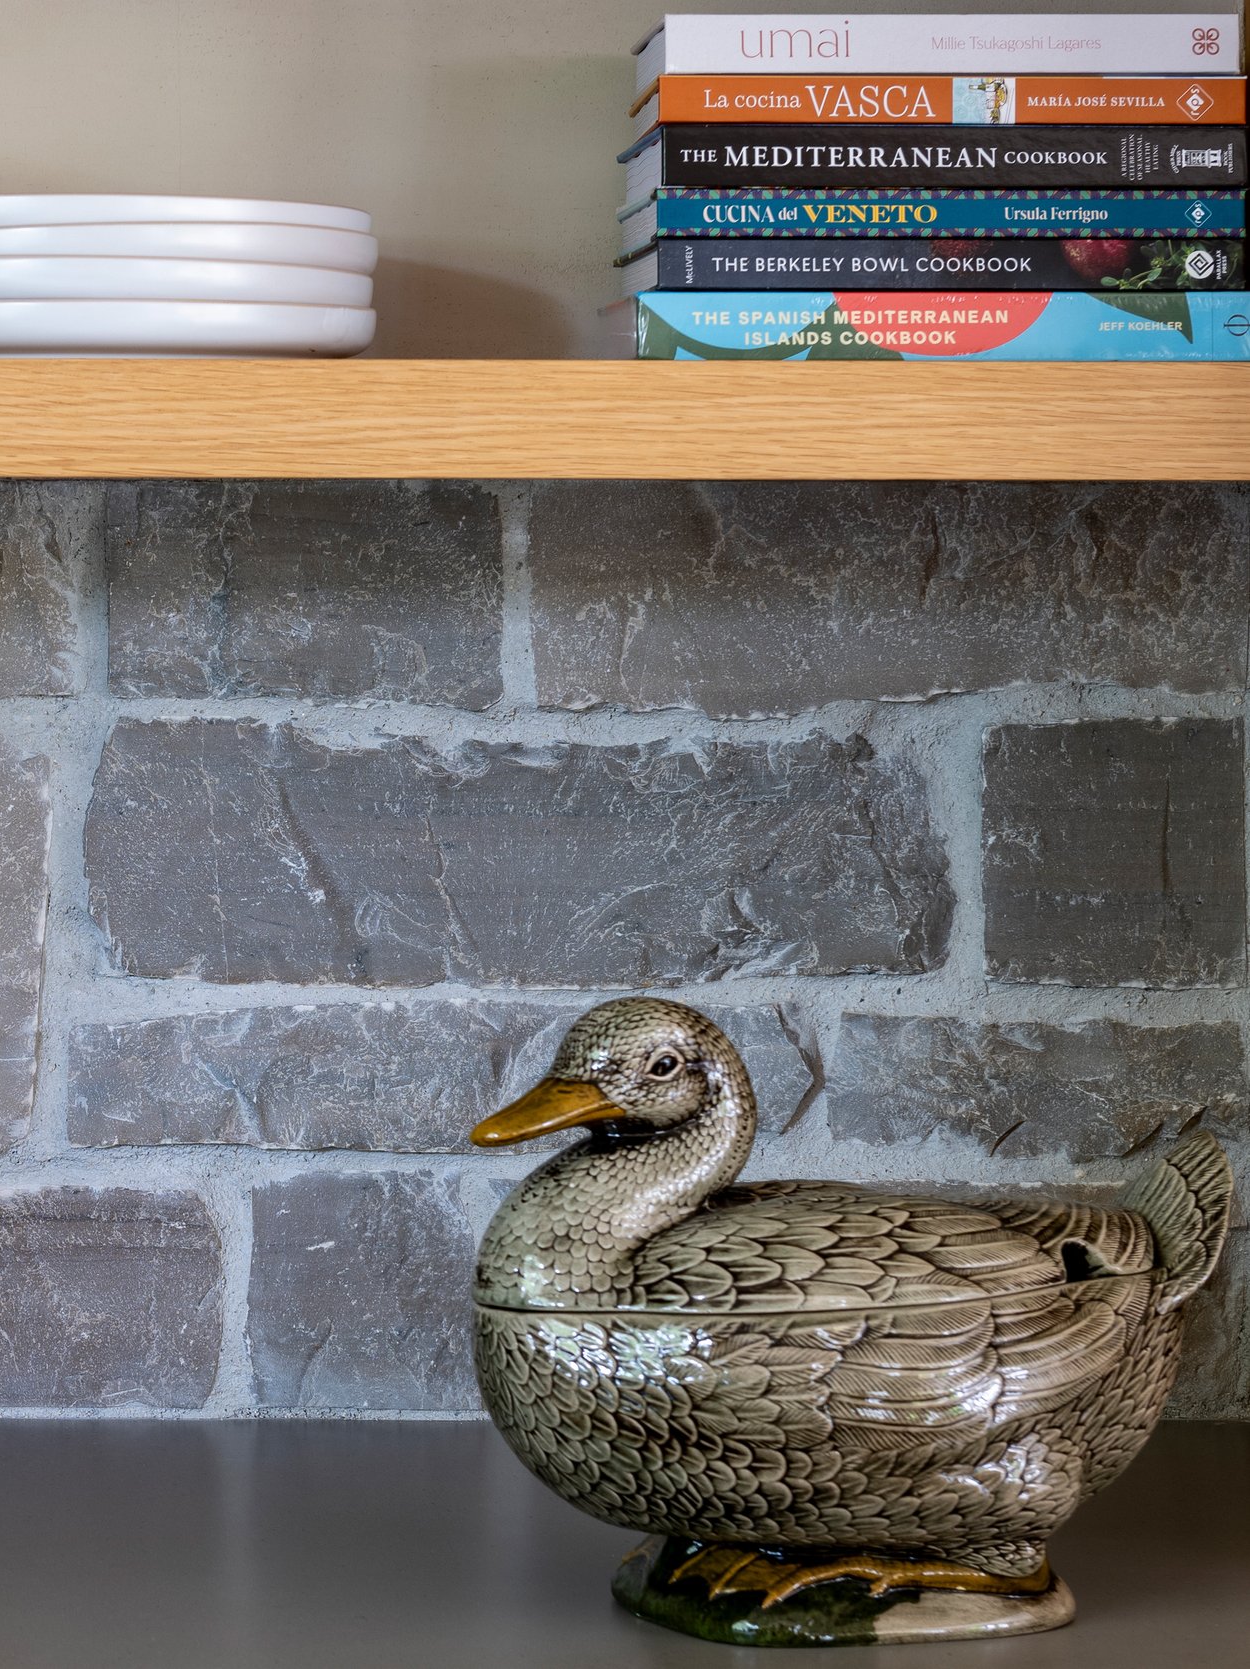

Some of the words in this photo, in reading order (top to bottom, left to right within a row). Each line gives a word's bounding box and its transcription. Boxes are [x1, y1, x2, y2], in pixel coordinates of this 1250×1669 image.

[740, 20, 851, 59] umai
[931, 36, 966, 50] Millie
[968, 36, 1044, 52] Tsukagoshi
[1048, 36, 1102, 52] Lagares
[704, 89, 729, 109] La
[734, 90, 802, 109] cocina
[805, 85, 937, 118] VASCA
[1027, 93, 1072, 107] MARÍA
[1074, 93, 1108, 108] JOSÉ
[1109, 96, 1166, 108] SEVILLA
[680, 149, 718, 163] THE
[723, 145, 998, 168] MEDITERRANEAN
[1004, 150, 1109, 166] COOKBOOK
[702, 204, 775, 223] CUCINA
[778, 206, 798, 221] del
[802, 204, 938, 224] VENETO
[1004, 206, 1048, 220] Ursula
[1050, 206, 1109, 224] Ferrigno
[712, 257, 749, 272] THE
[755, 257, 845, 273] BERKELEY
[851, 257, 909, 273] BOWL
[916, 257, 1032, 273] COOKBOOK
[692, 311, 731, 325] THE
[738, 311, 826, 325] SPANISH
[834, 310, 1009, 325] MEDITERRANEAN
[1098, 322, 1125, 332] JEFF
[1128, 321, 1183, 331] KOEHLER
[744, 331, 833, 345] ISLANDS
[839, 331, 957, 345] COOKBOOK
